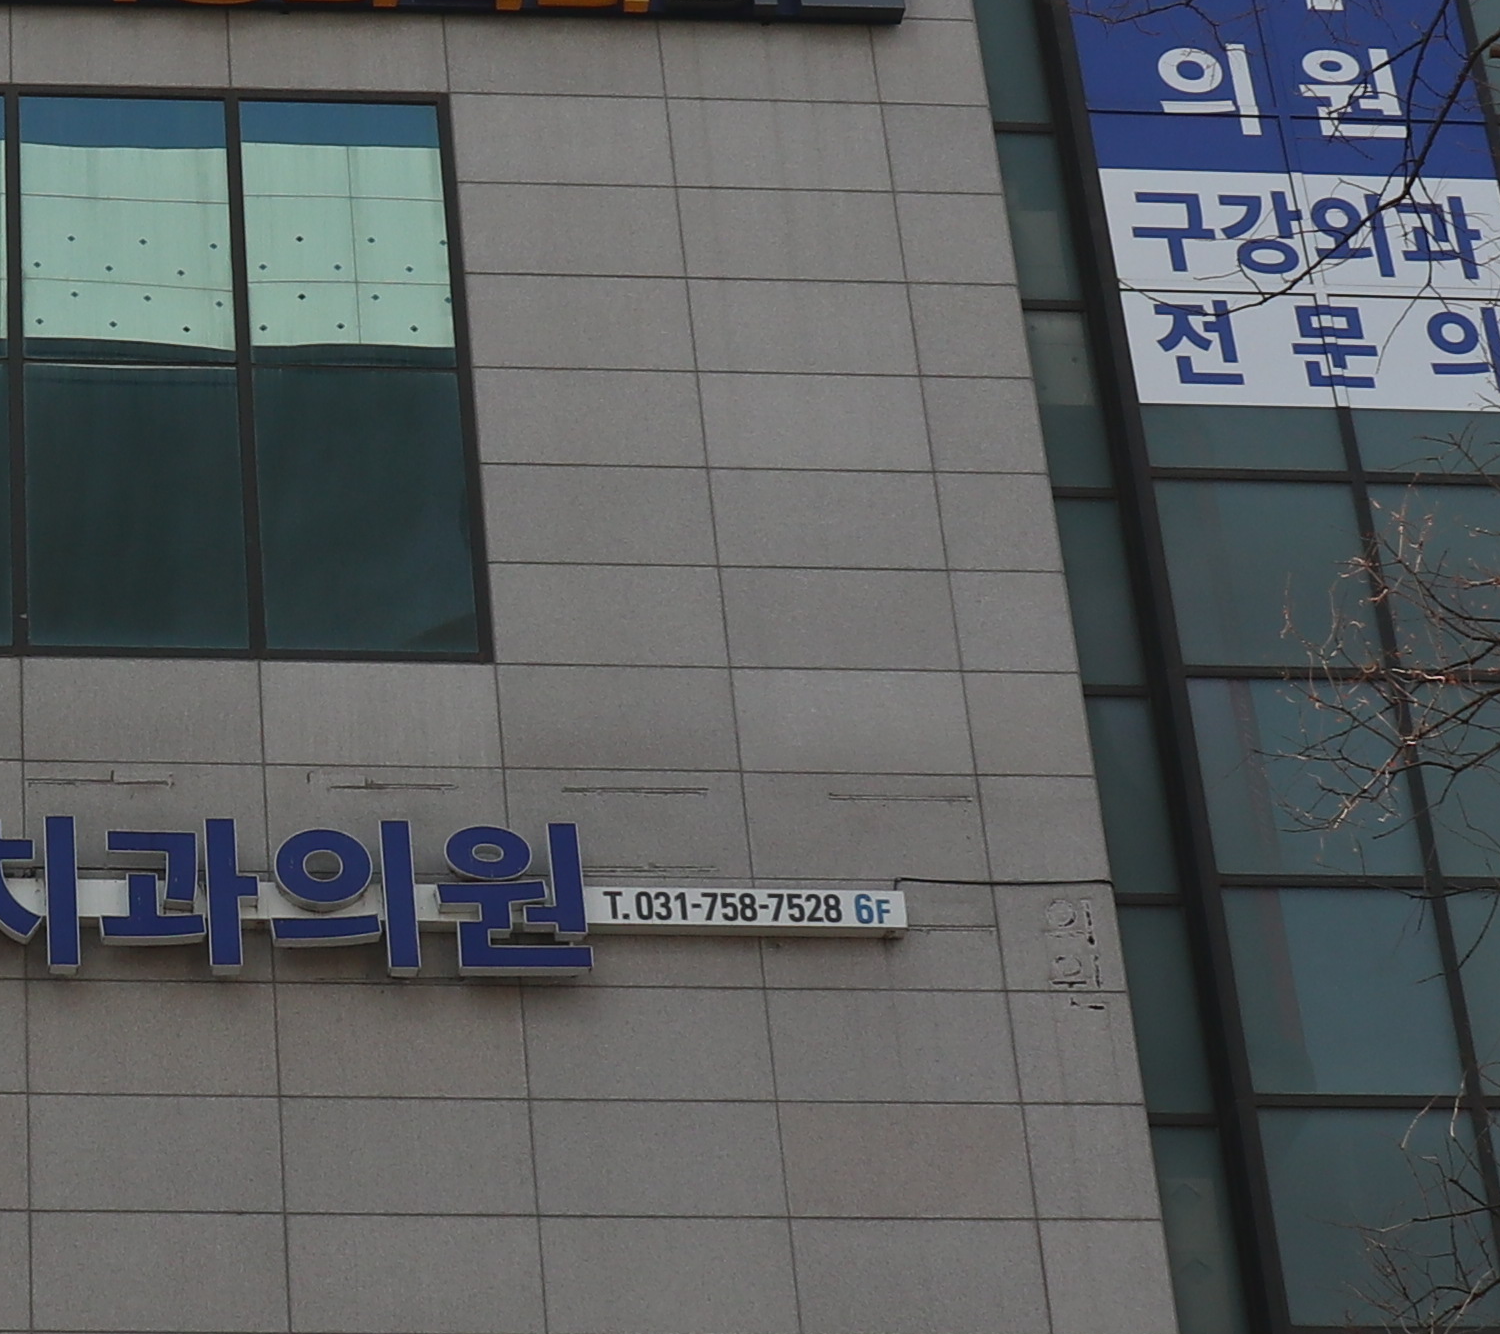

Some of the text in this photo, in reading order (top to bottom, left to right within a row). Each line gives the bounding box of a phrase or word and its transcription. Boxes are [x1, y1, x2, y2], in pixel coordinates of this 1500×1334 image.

[1157, 43, 1407, 139] 의원
[1131, 191, 1482, 283] 구강외과
[854, 893, 891, 924] 6F
